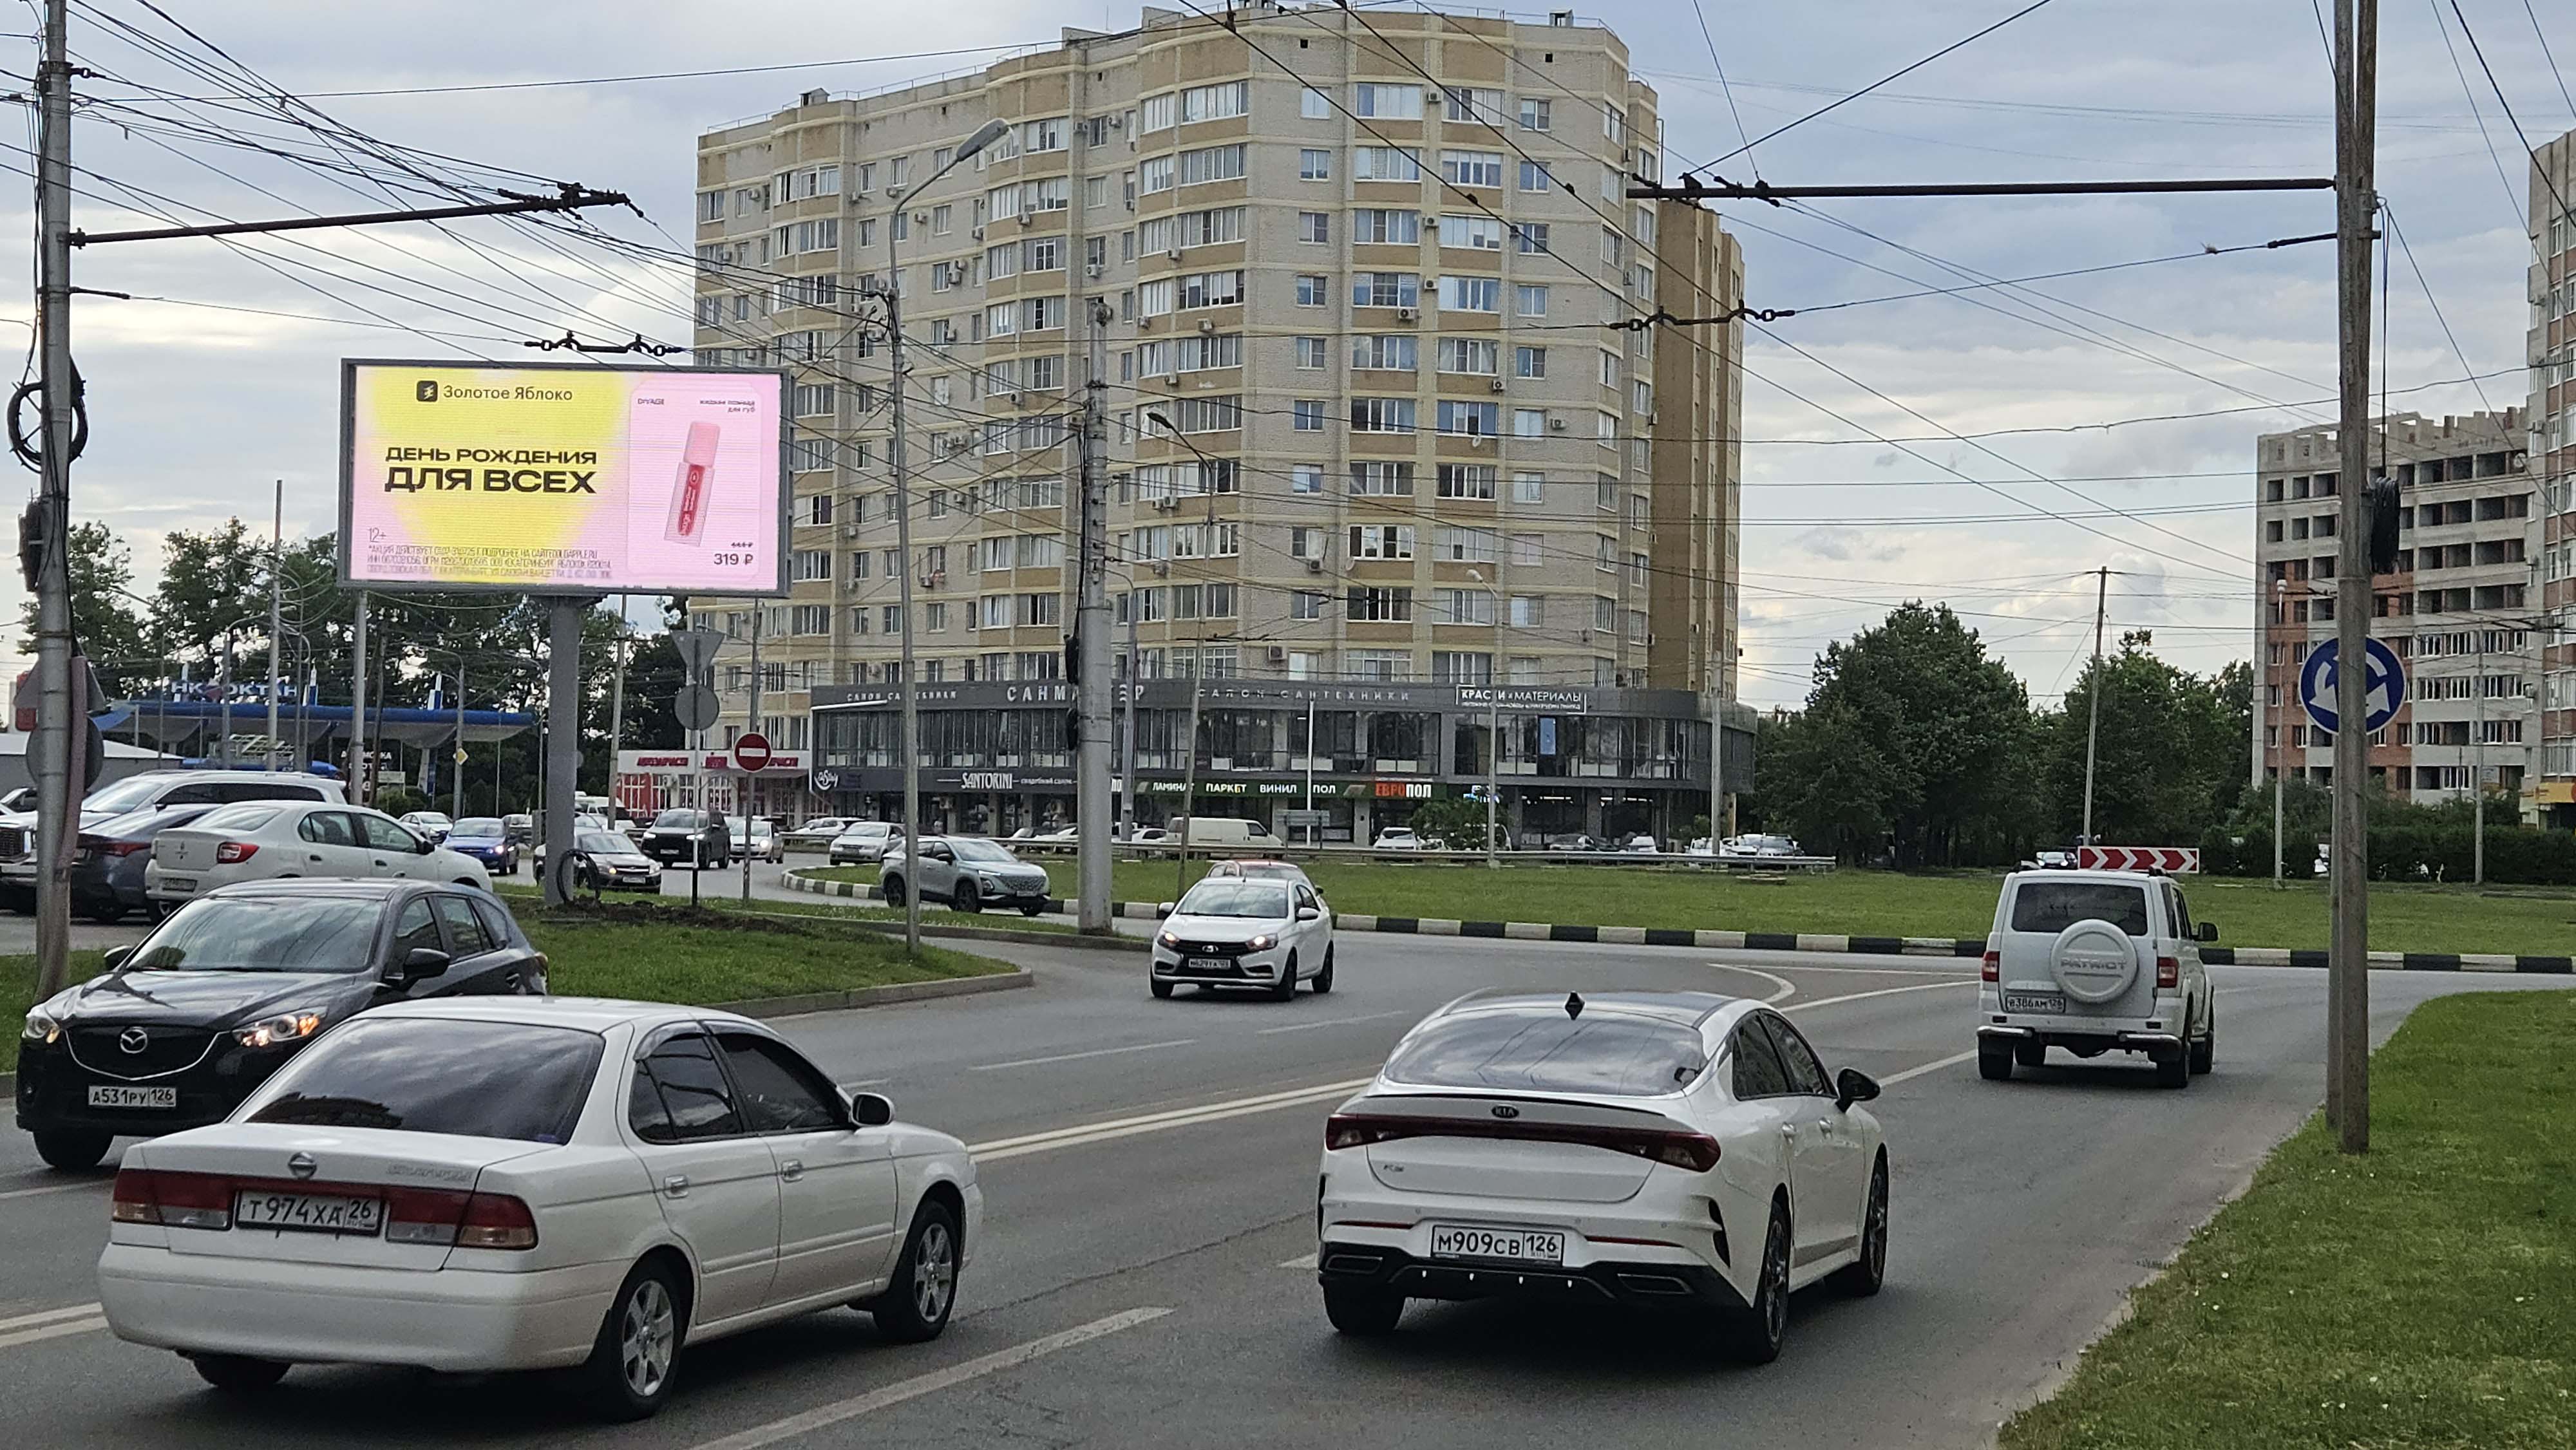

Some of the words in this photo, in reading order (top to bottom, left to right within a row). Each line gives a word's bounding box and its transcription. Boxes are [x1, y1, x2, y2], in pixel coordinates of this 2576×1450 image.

[443, 385, 510, 399] Золотое
[515, 386, 573, 400] Яблоко
[385, 447, 450, 462] ДЕНЬ
[456, 449, 596, 465] РОЖДЕНИЯ
[384, 467, 472, 493] ДЛЯ
[484, 469, 597, 494] ВСЕХ
[368, 527, 386, 543] 12+
[714, 553, 739, 565] 319
[1198, 689, 1264, 698] САЛОН
[1280, 690, 1408, 700] САНТЕХНИКИ
[1461, 689, 1505, 701] КРАСИ
[1514, 691, 1581, 702] МАТЕРИАЛЫ
[961, 773, 1012, 789] SANTORINI
[1206, 783, 1247, 793] ПАРКЕТ
[1260, 784, 1298, 794] ВИНИЛ
[1312, 784, 1336, 794] ПОЛ
[1375, 782, 1432, 798] ЕВРОПОЛ
[2061, 957, 2126, 970] PATRIOT
[93, 1088, 147, 1104] А531РУ
[150, 1088, 173, 1101] 126
[1495, 1107, 1514, 1116] KIA
[249, 1196, 343, 1225] Т974ХА
[348, 1199, 371, 1219] 26
[1438, 1231, 1520, 1256] М909СВ
[1526, 1234, 1558, 1253] 126
